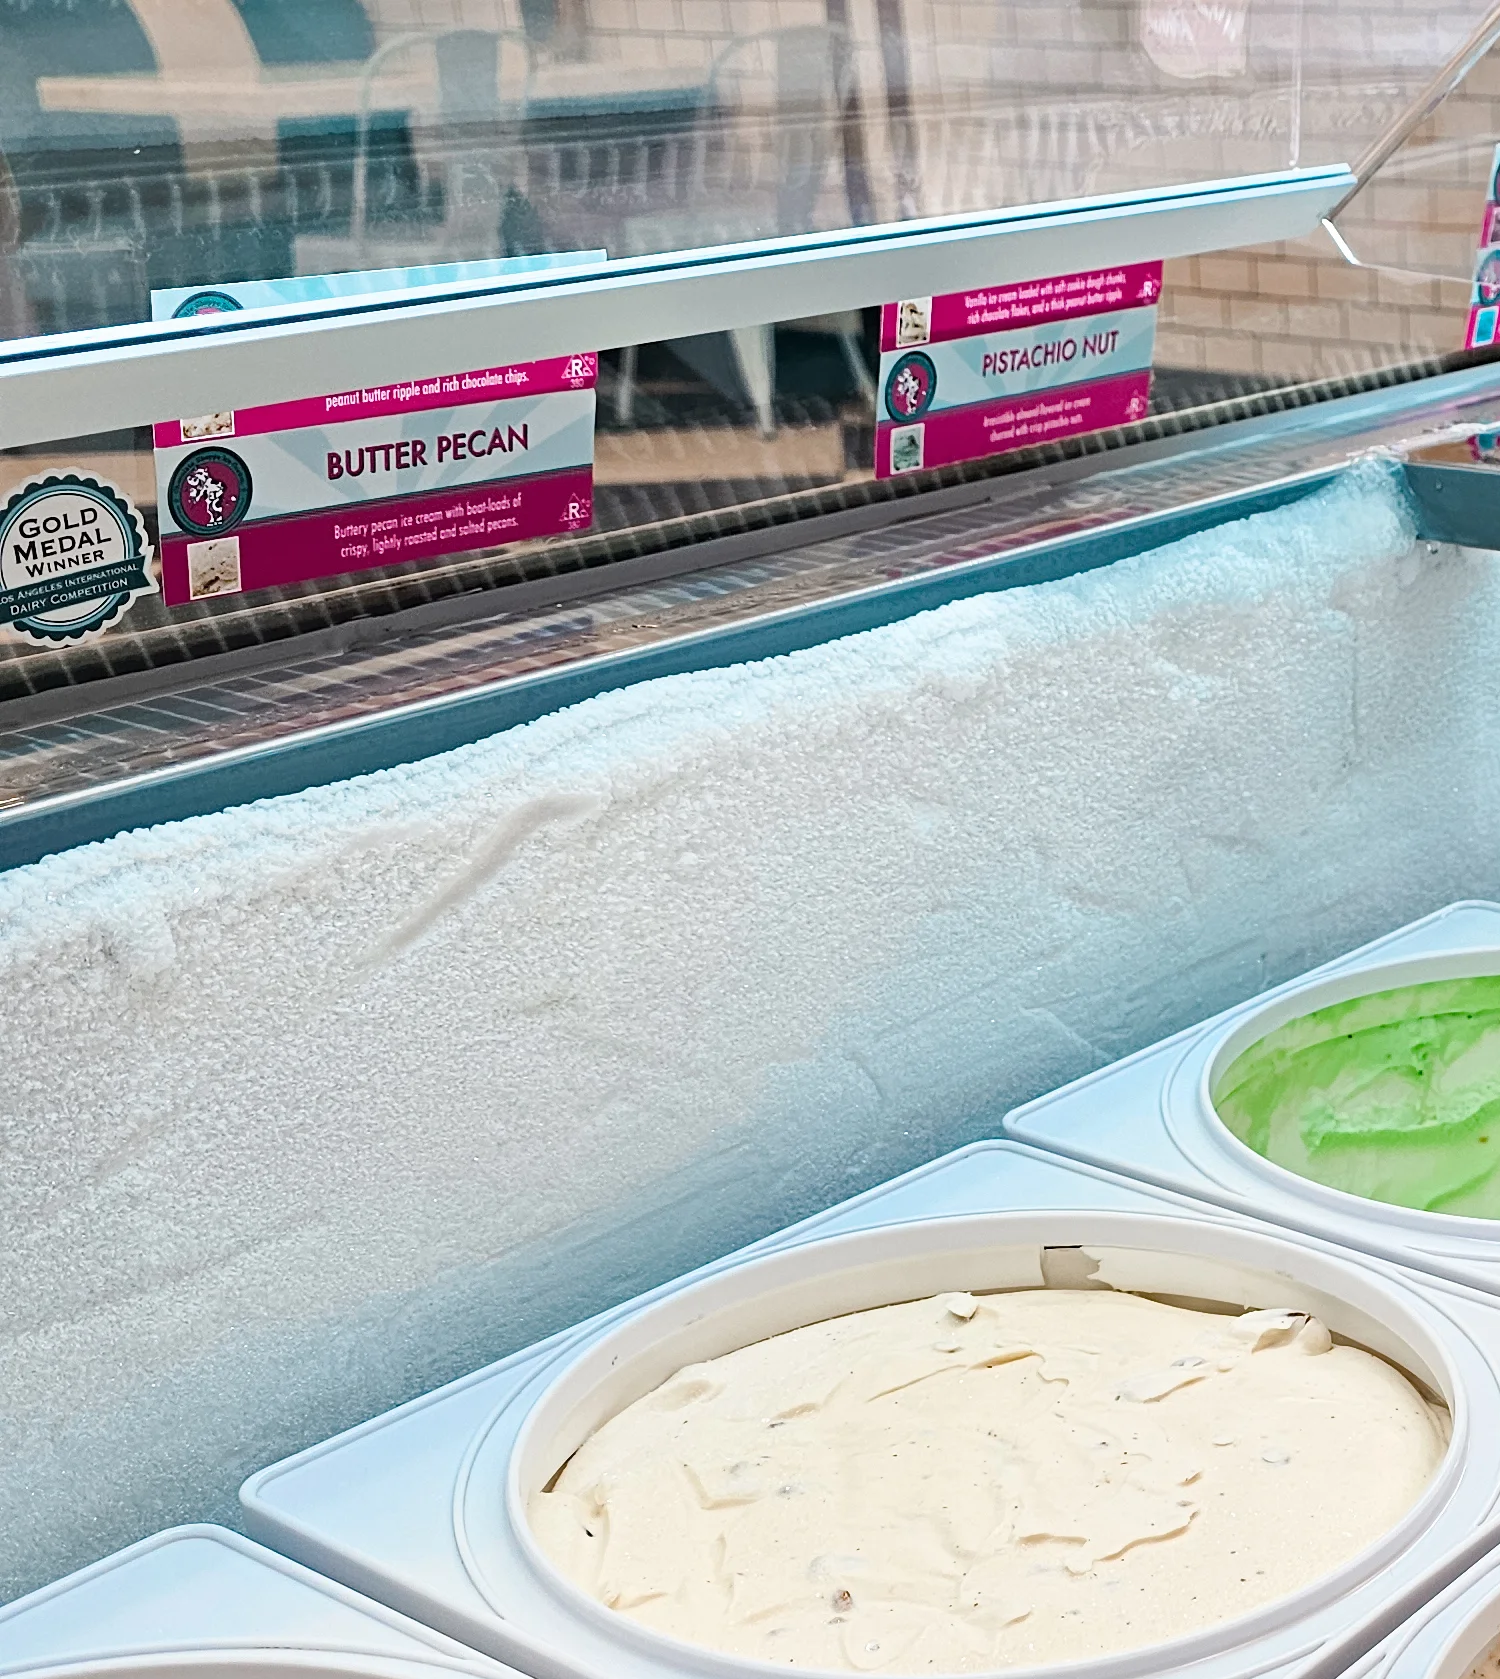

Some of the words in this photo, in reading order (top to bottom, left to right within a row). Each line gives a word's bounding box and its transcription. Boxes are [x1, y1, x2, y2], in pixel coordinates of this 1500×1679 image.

[981, 337, 1078, 378] PISTACHIO
[1081, 329, 1121, 359] NUT
[325, 394, 360, 411] peanut
[361, 388, 391, 403] butter
[392, 383, 421, 401] ripple
[422, 378, 441, 395] and
[442, 375, 460, 393] rich
[461, 371, 503, 389] chocolate
[504, 368, 530, 386] chips.
[326, 438, 429, 481] BUTTER
[436, 422, 529, 463] PECAN
[334, 522, 369, 541] Buttery
[370, 518, 399, 538] pecan
[400, 514, 414, 528] ice
[414, 511, 444, 526] cream
[445, 506, 465, 520] with
[466, 497, 511, 517] boat-loads
[511, 491, 523, 508] of
[340, 539, 371, 559] crispy,
[372, 533, 403, 553] lightly
[403, 526, 438, 547] roasted
[439, 522, 458, 541] and
[458, 518, 486, 538] salted
[487, 513, 520, 534] pecans.
